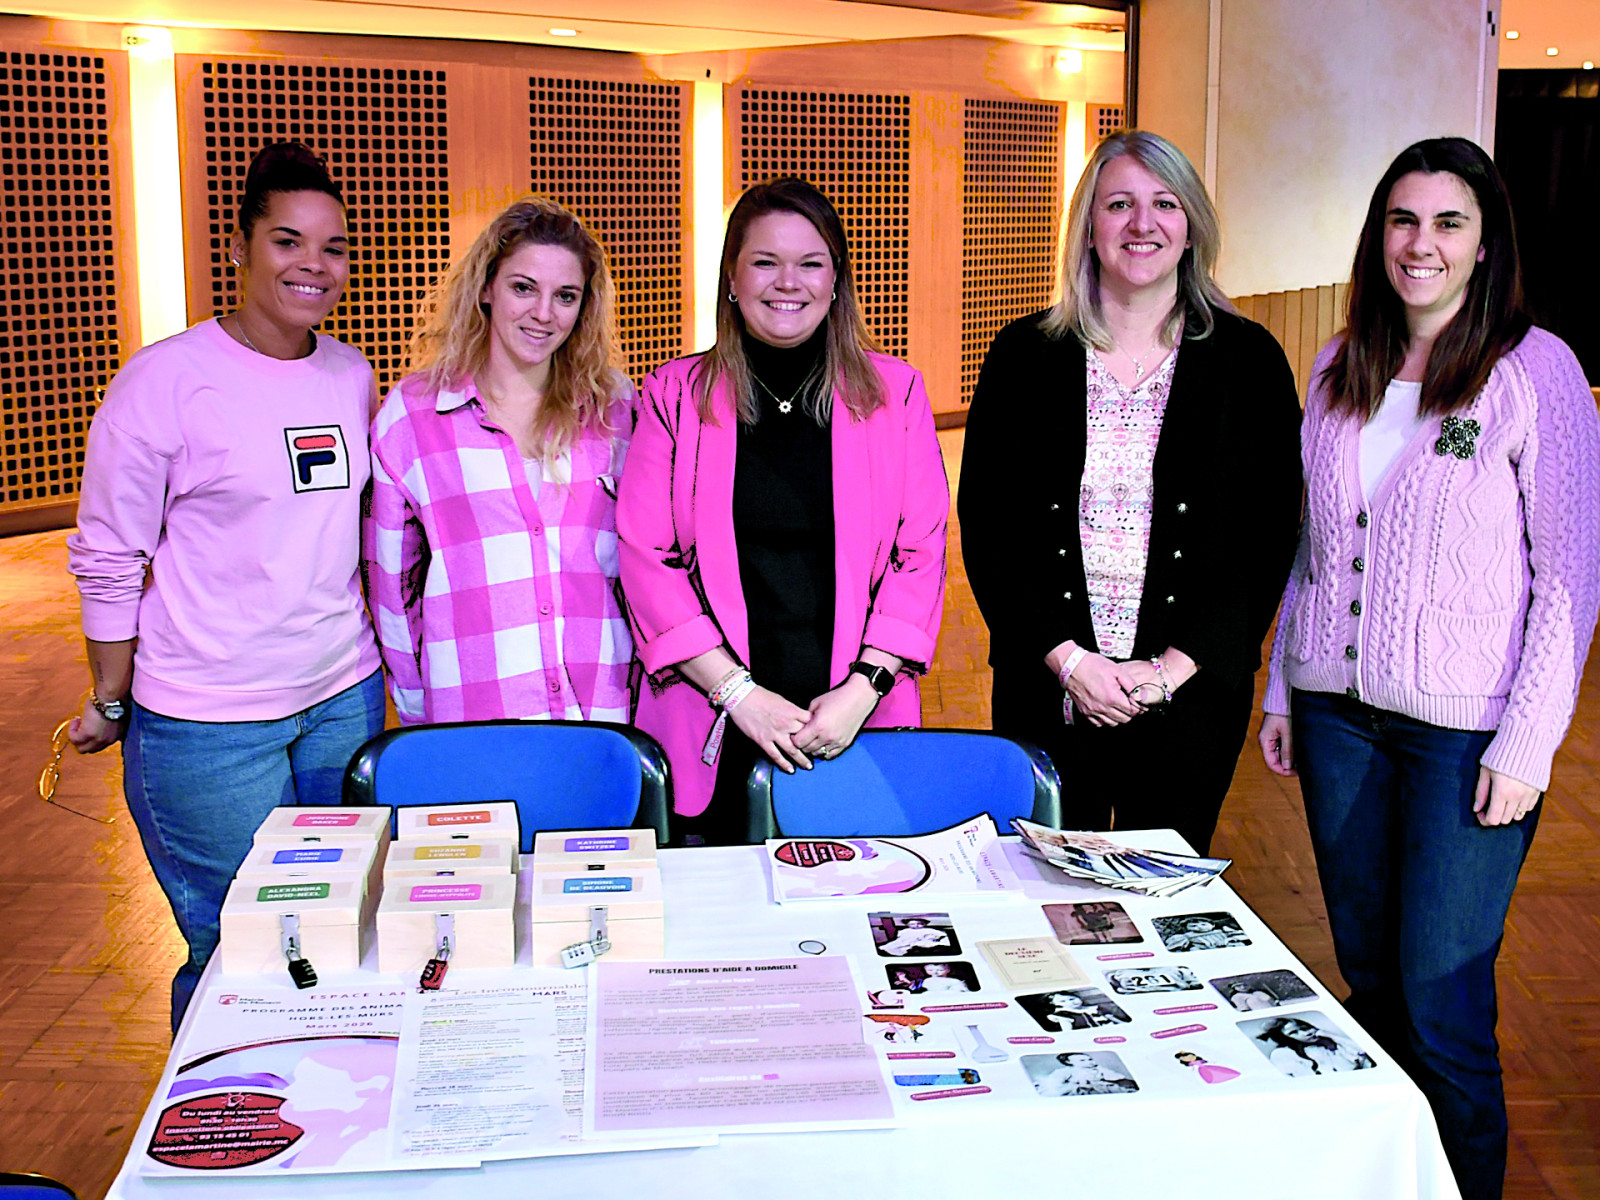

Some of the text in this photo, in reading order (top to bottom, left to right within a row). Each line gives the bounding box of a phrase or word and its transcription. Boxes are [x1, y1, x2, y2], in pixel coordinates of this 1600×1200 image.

[310, 991, 370, 1000] ESPACE
[289, 1011, 394, 1021] HORS-LES-MURS
[237, 1108, 278, 1116] vendredi
